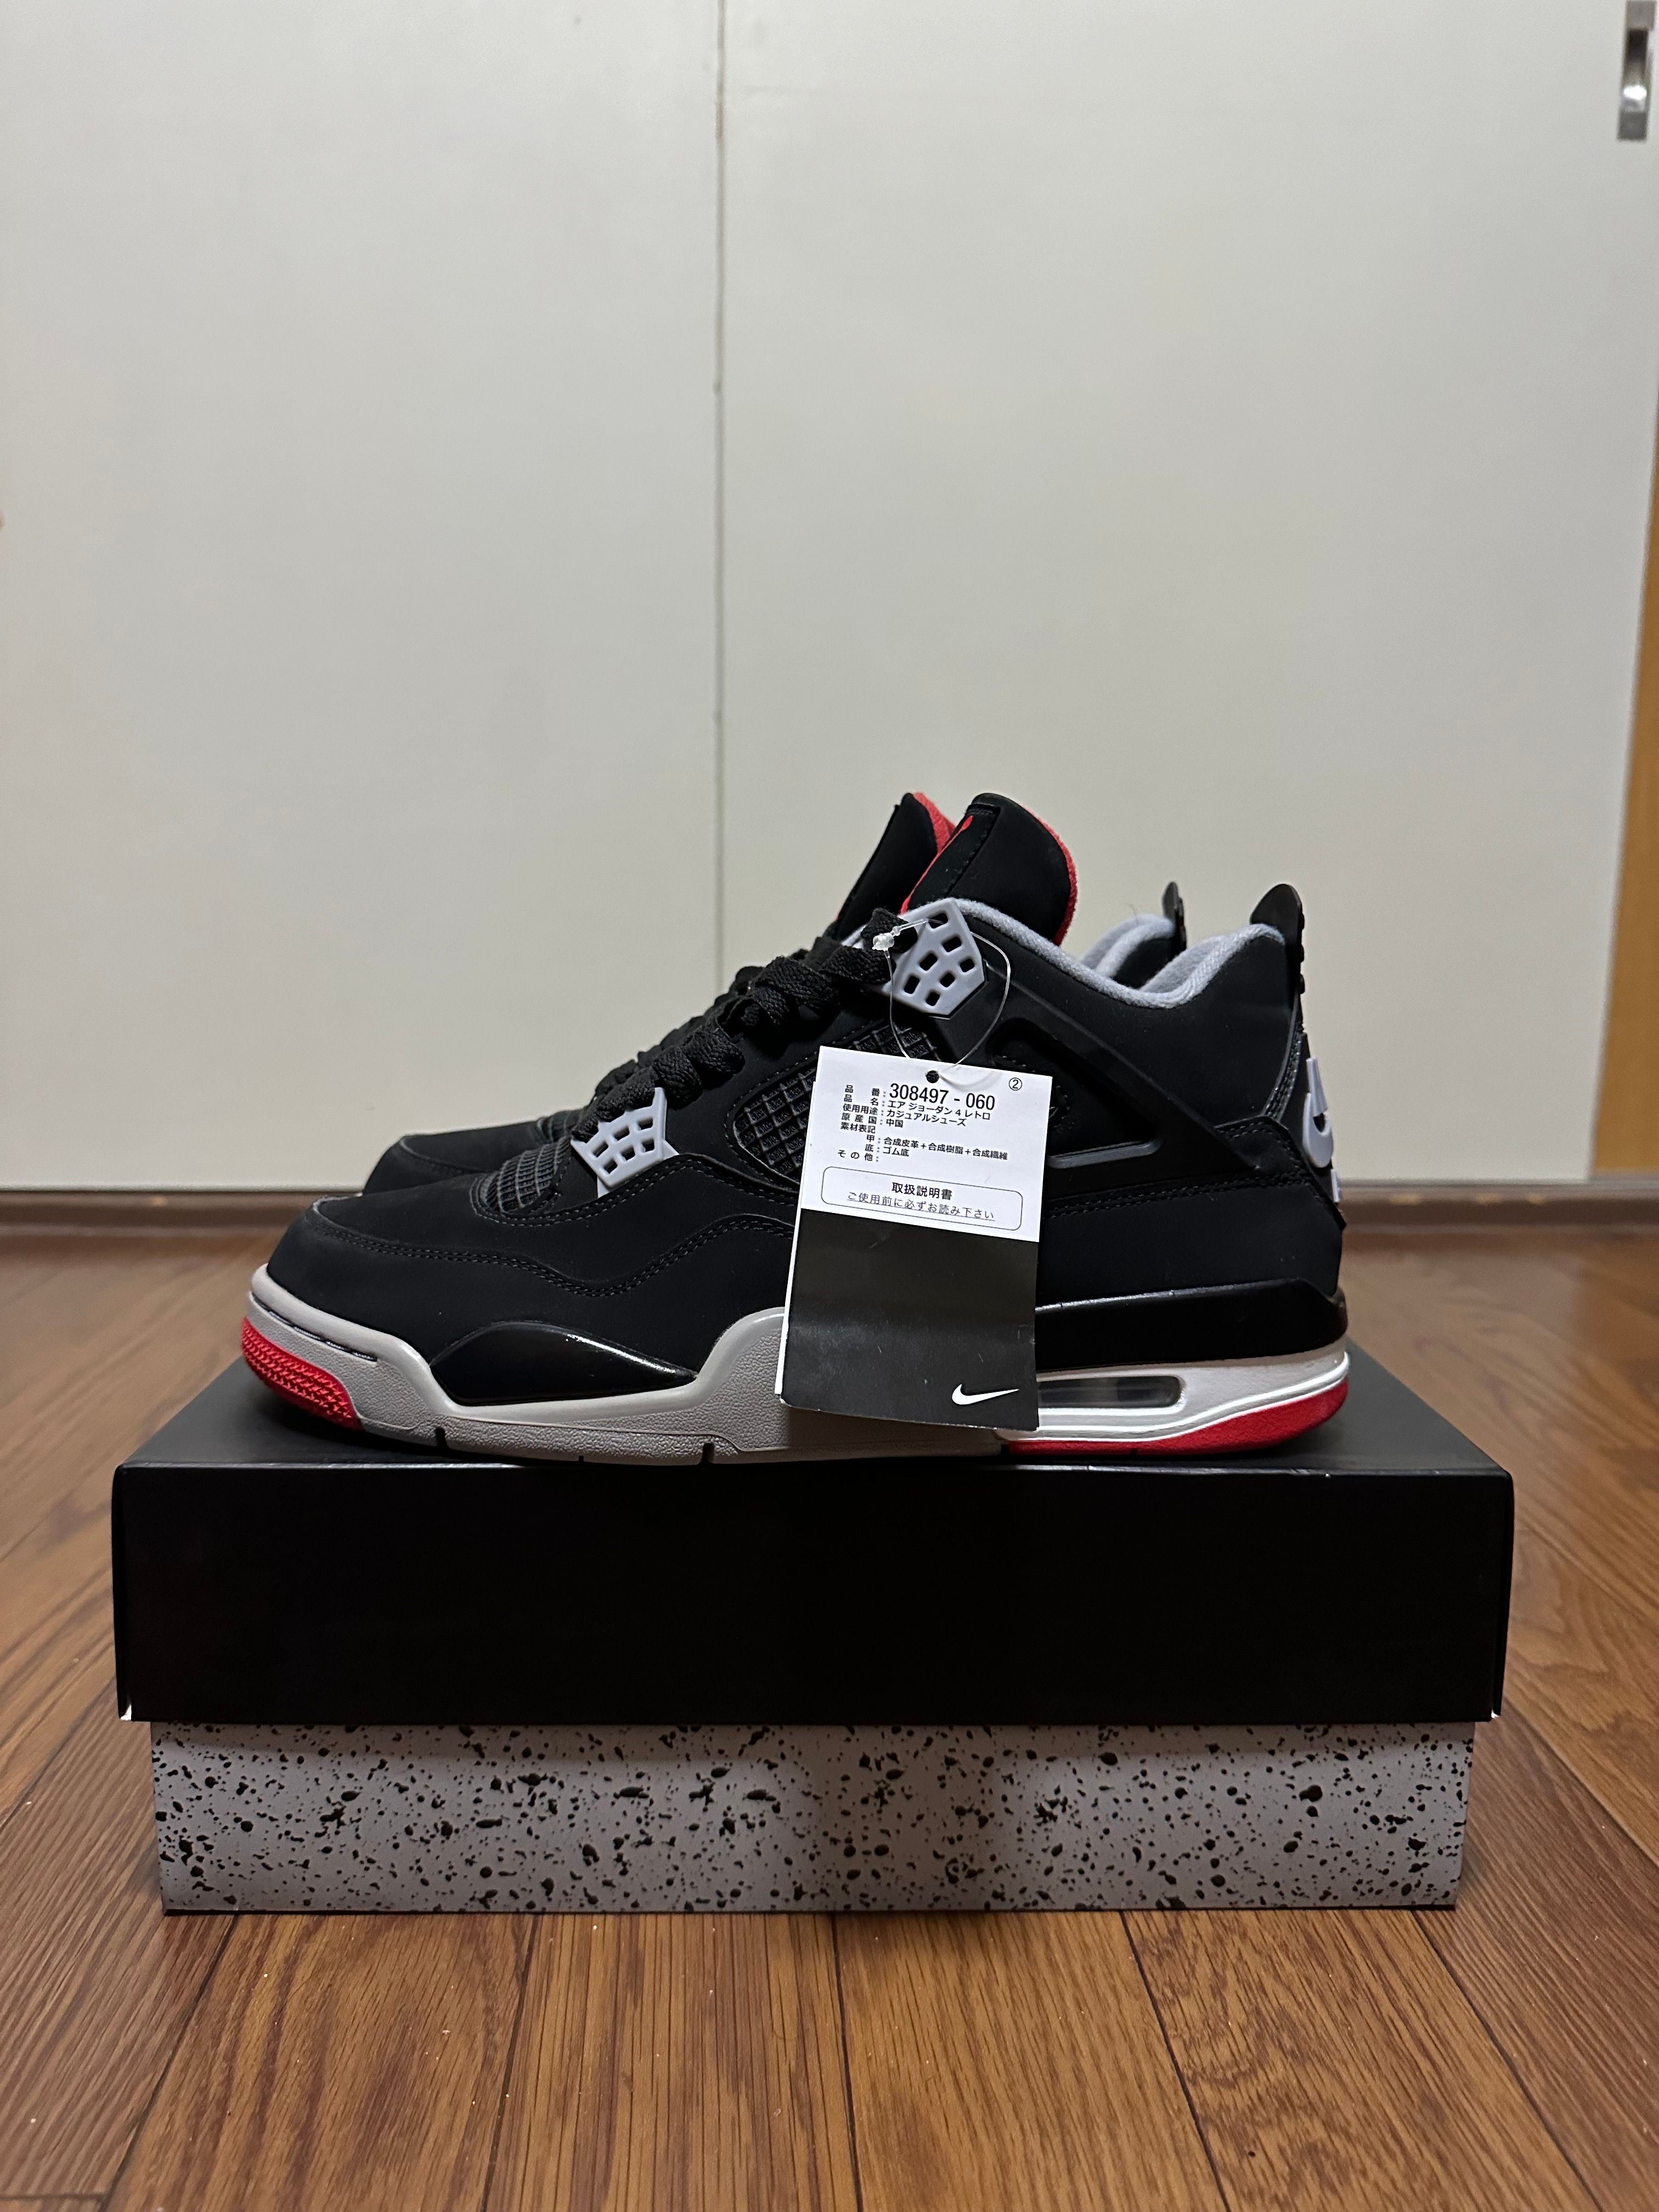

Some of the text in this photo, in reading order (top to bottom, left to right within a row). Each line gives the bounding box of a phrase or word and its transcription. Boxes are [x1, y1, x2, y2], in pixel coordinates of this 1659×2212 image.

[889, 1083, 949, 1104] 308497
[966, 1093, 995, 1110] 060
[887, 1109, 967, 1126] カジュアルシューズ
[965, 1110, 990, 1120] レトロ
[840, 1122, 876, 1133] 素材表記
[886, 1119, 904, 1127] 中国
[883, 1147, 909, 1156] ゴム底
[891, 1182, 952, 1200] 取扱説明書
[848, 1192, 994, 1219] ご使用前に必ずお読み下さい
